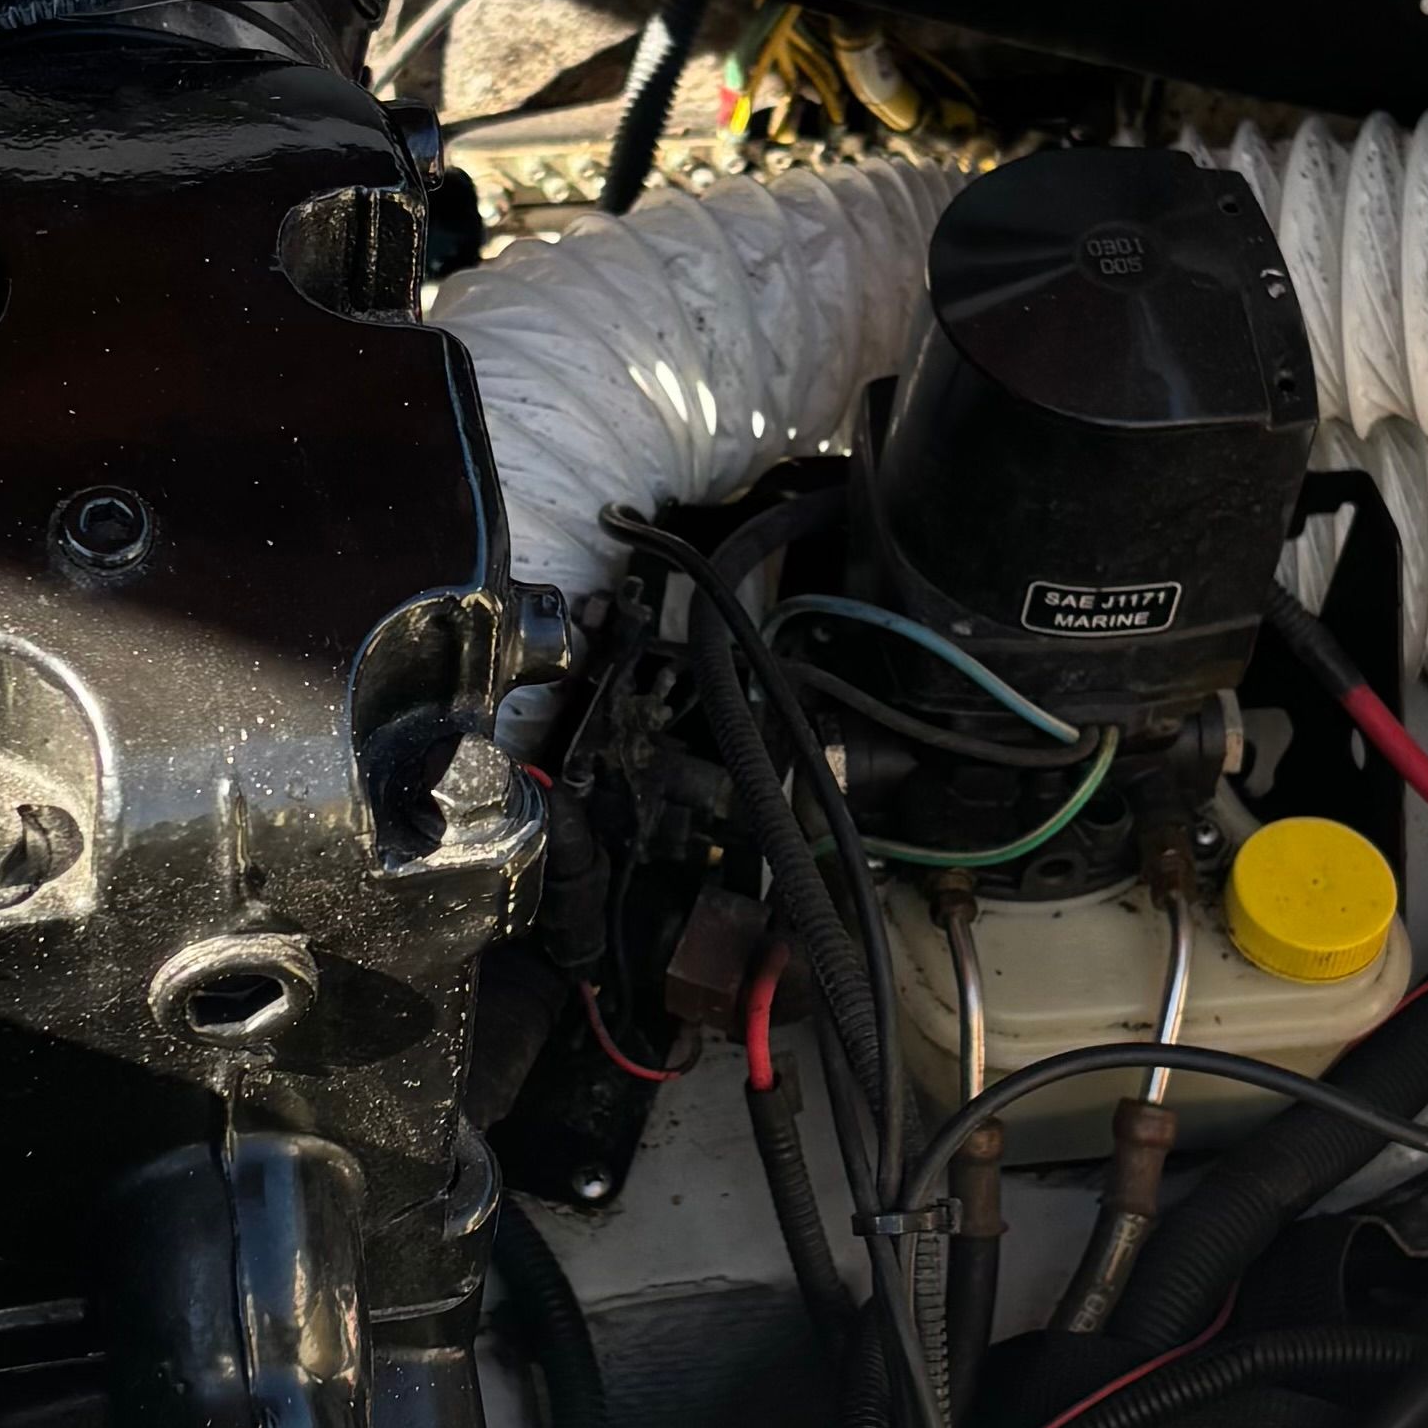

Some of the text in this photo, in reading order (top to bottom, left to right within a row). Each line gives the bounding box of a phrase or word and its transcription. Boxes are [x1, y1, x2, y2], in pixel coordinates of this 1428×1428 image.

[1043, 590, 1167, 611] SAE J1171
[1052, 610, 1151, 630] MARINE
